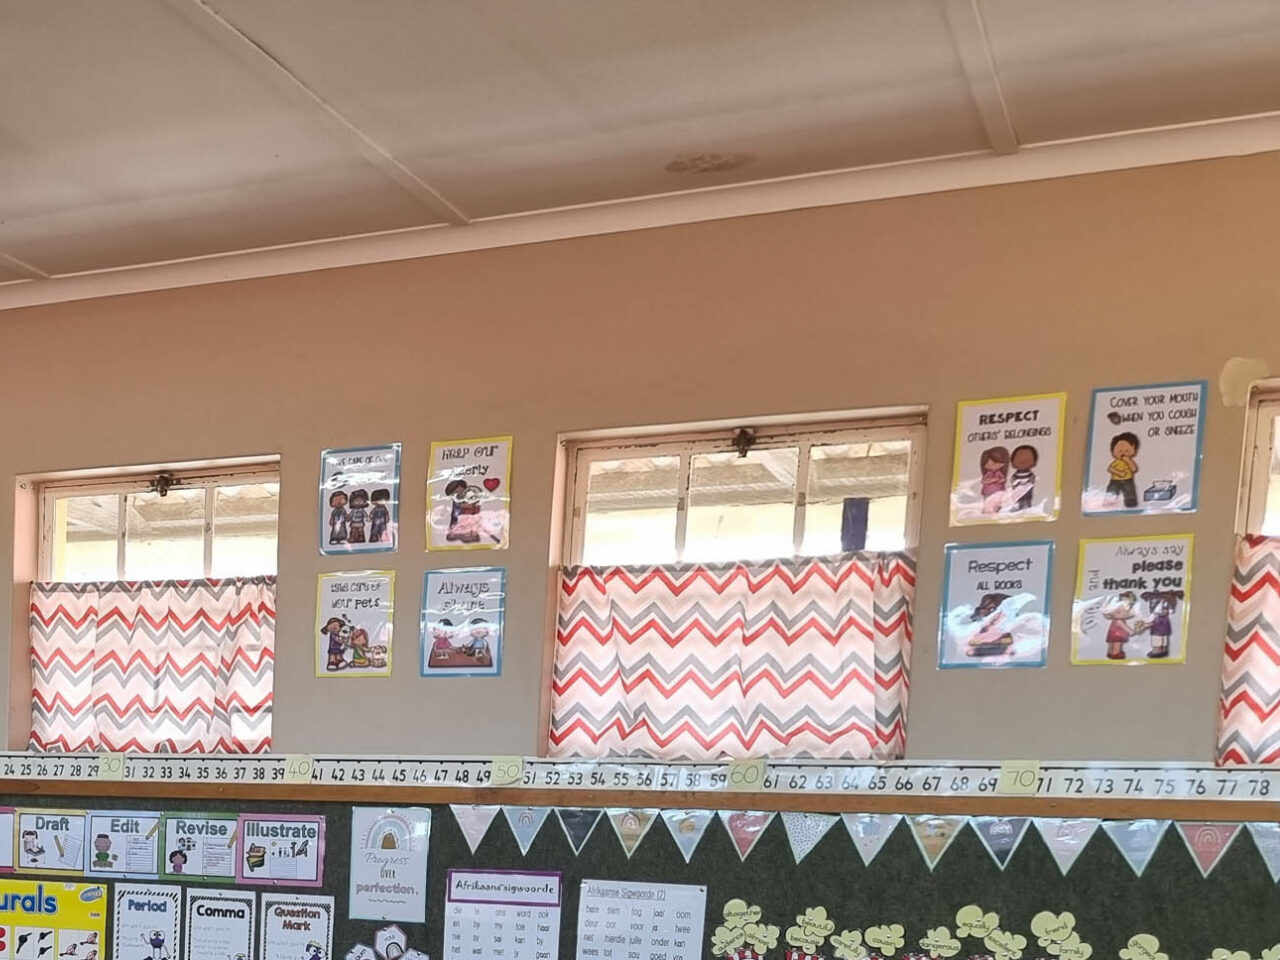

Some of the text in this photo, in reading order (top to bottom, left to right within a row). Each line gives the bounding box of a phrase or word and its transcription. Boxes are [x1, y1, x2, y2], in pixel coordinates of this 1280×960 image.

[1110, 392, 1198, 408] COVER YOUR MOUTH
[979, 409, 1039, 425] RESPECT
[1121, 408, 1197, 422] WHEN YOU COUGH
[1147, 424, 1195, 437] OR SNEEZE
[1115, 544, 1185, 557] Always say
[968, 557, 1033, 576] Respect
[1132, 559, 1184, 573] please
[976, 579, 1023, 591] ALL BOOKS
[1103, 576, 1182, 590] thank you
[355, 597, 380, 609] pets
[101, 758, 121, 772] 30
[197, 767, 209, 778] 35
[288, 761, 311, 778] 40
[392, 769, 406, 780] 45
[730, 765, 759, 784] 60
[922, 777, 941, 791] 67
[1249, 779, 1270, 796] 78
[35, 816, 69, 831] Draft
[111, 818, 140, 833] Edit
[176, 820, 228, 835] Revise
[246, 822, 317, 838] Illustrate
[365, 852, 410, 869] Progress
[127, 899, 167, 913] Period
[196, 904, 245, 919] Comma
[274, 907, 321, 919] Question
[282, 921, 311, 932] Mark
[790, 935, 821, 946] because
[872, 937, 897, 946] cousin
[1058, 946, 1084, 959] family
